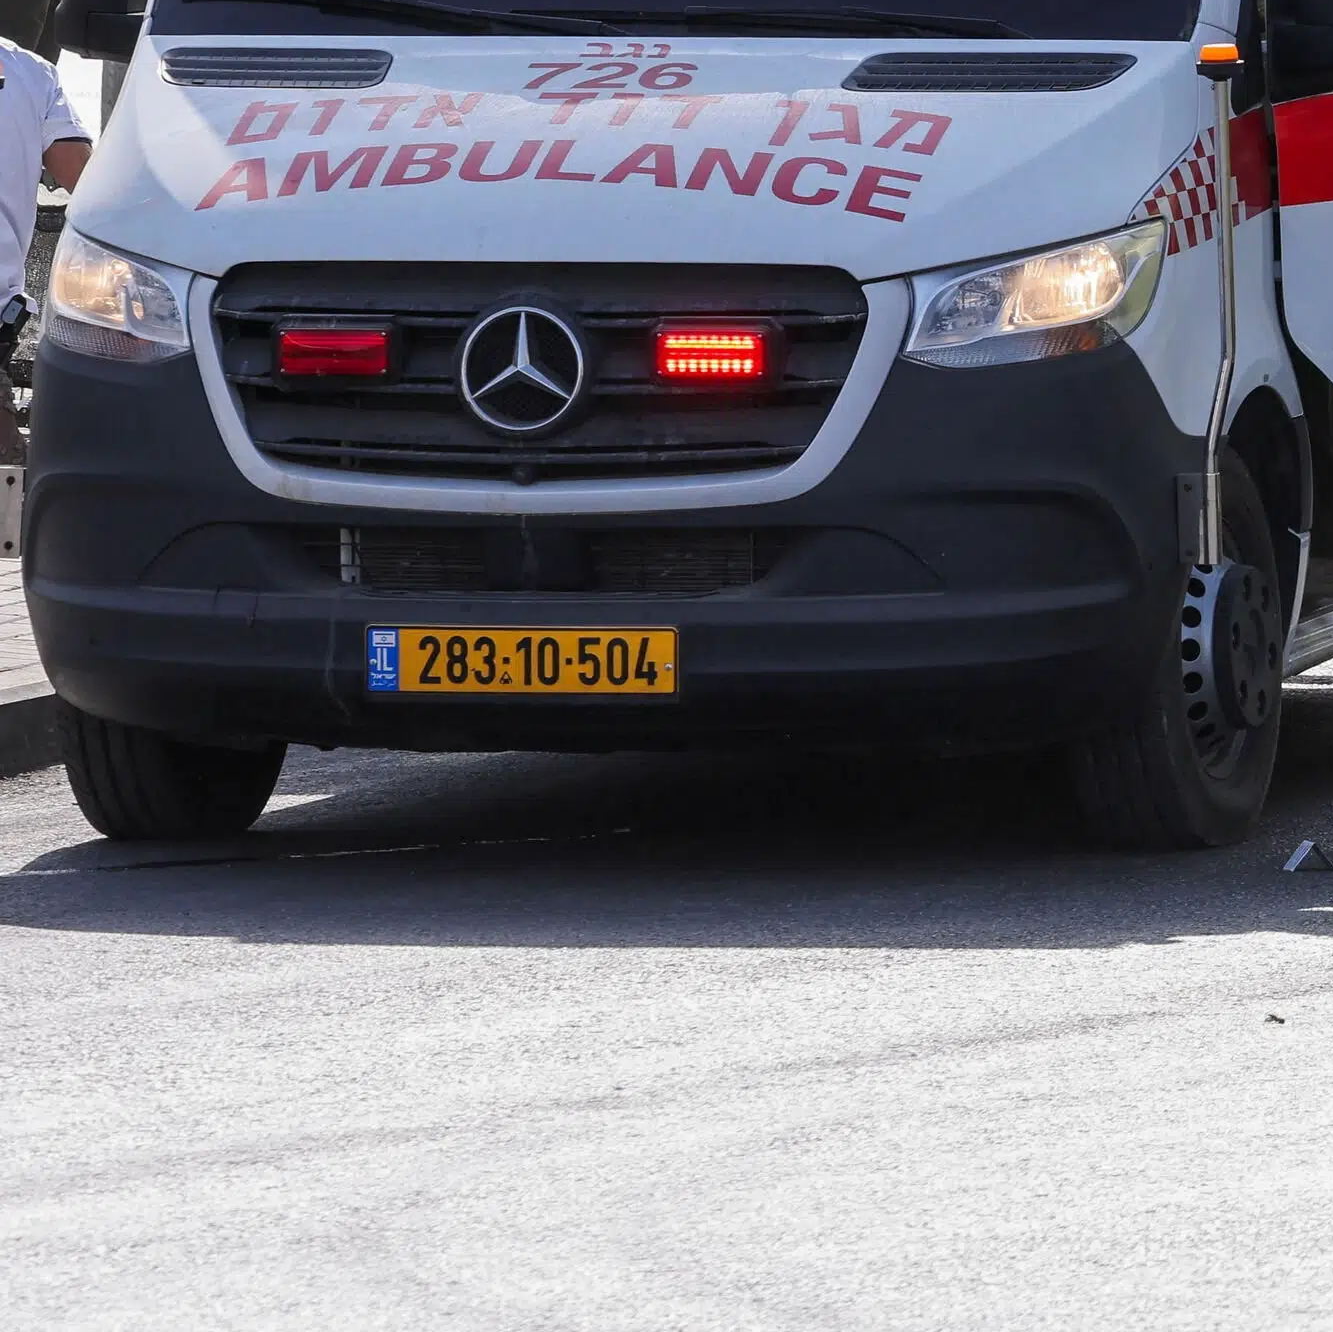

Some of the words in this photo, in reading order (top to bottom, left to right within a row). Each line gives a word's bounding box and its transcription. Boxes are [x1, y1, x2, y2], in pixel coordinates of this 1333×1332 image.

[578, 42, 671, 59] נגב
[523, 62, 700, 90] 726
[224, 92, 483, 146] אדום
[538, 92, 726, 132] דוד
[769, 99, 954, 156] מגן
[193, 139, 924, 223] AMBULANCE
[376, 648, 393, 671] IL
